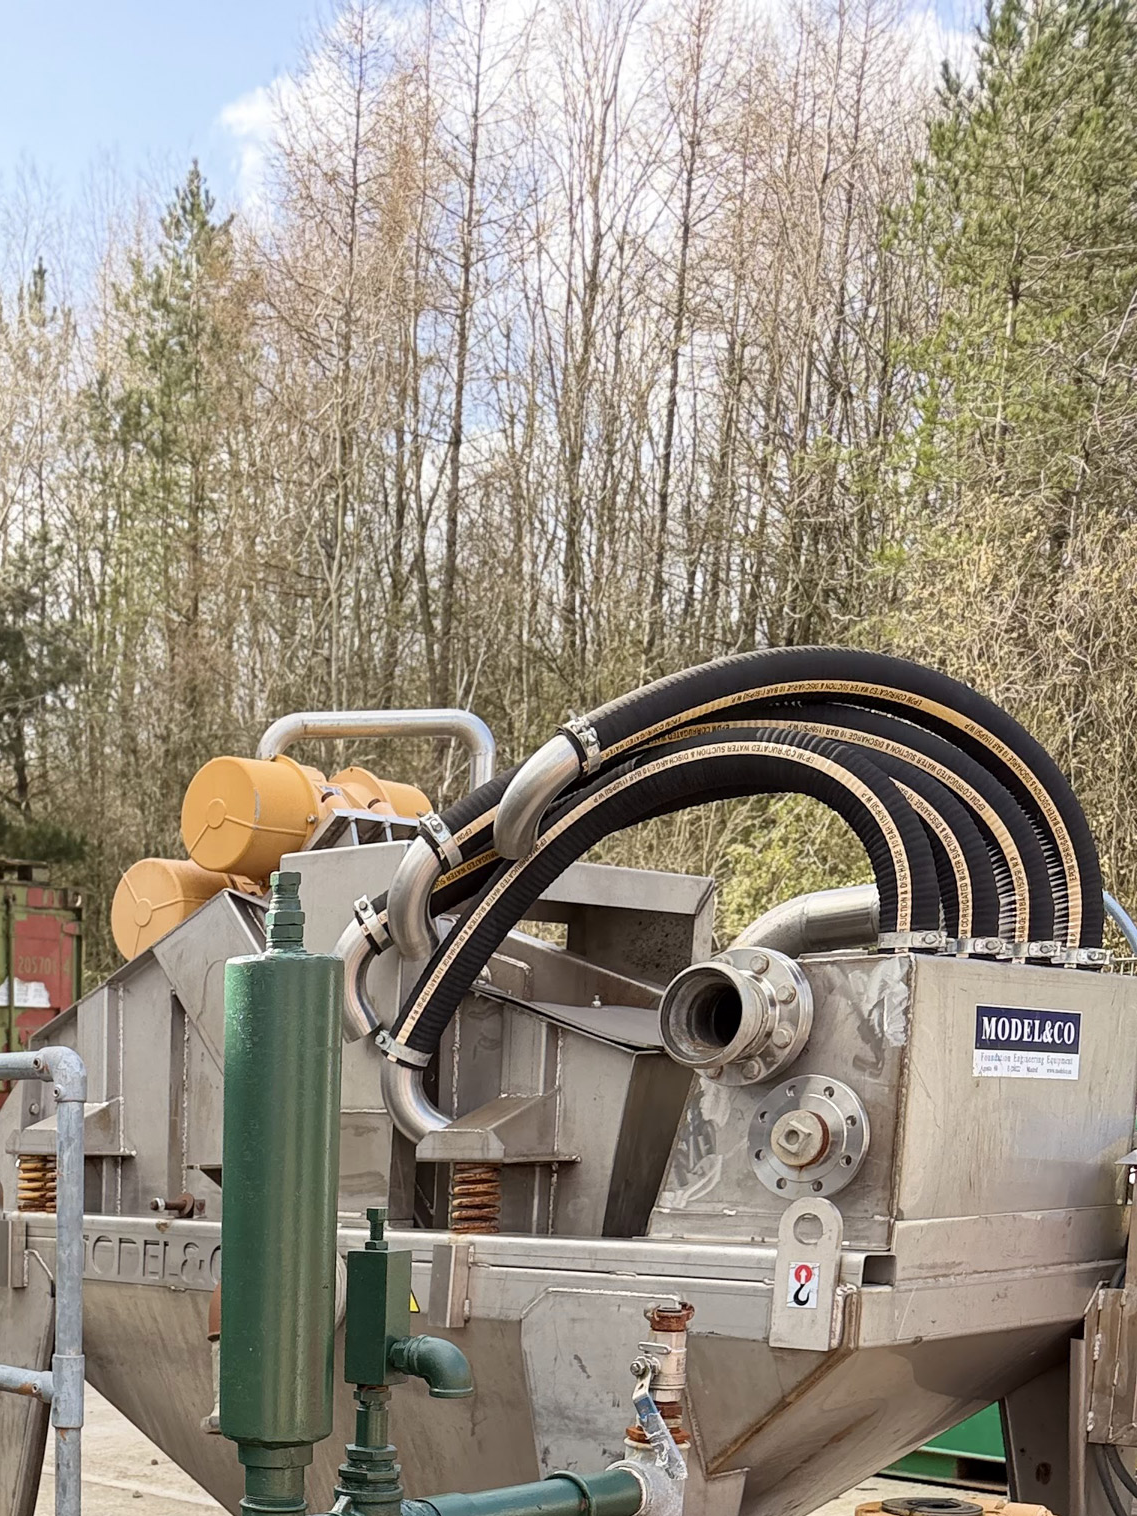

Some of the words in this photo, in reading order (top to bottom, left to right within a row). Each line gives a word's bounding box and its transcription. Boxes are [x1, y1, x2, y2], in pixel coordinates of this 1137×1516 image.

[765, 686, 777, 694] BAR
[786, 683, 819, 692] DISCHARGE
[850, 684, 869, 693] WATER
[869, 686, 907, 701] CORRUGATED
[906, 695, 922, 706] EPDM
[825, 728, 839, 738] BAR
[839, 730, 847, 739] 10
[847, 731, 885, 749] DISCHARGE
[695, 745, 726, 757] SUCTION
[726, 744, 749, 752] WATER
[889, 744, 917, 762] SUCTION
[992, 741, 1005, 753] BAR
[650, 752, 689, 771] DISCHARGE
[796, 751, 815, 764] EPDM
[915, 756, 937, 773] WATER
[627, 769, 643, 781] BAR
[641, 765, 651, 775] 10
[1006, 754, 1033, 783] DISCHARGE
[935, 767, 973, 798] CORRUGATED
[906, 792, 916, 802] 10
[969, 794, 987, 811] EPDM
[1031, 784, 1051, 809] SUCTION
[913, 797, 943, 829] DISCHARGE
[1045, 806, 1060, 826] WATER
[457, 828, 473, 844] EPDM
[885, 824, 896, 839] BAR
[938, 826, 946, 834] &
[891, 839, 900, 848] 10
[940, 831, 960, 860] SUCTION
[1054, 825, 1074, 863] CORRUGATED
[444, 866, 467, 881] WATER
[894, 848, 907, 888] DISCHARGE
[953, 858, 967, 881] WATER
[1067, 864, 1077, 881] EPDM
[484, 886, 503, 908] WATER
[959, 881, 970, 928] CORRUGATED
[466, 905, 488, 932] SUCTION
[899, 896, 908, 926] SUCTION
[462, 928, 471, 936] &
[1017, 916, 1027, 943] CHARGE
[440, 934, 467, 968] DISCHARGE
[981, 1016, 1075, 1045] MODEL&CO
[980, 1052, 1011, 1063] Foundation
[1013, 1053, 1045, 1066] Engineering
[1047, 1054, 1073, 1067] Equipment
